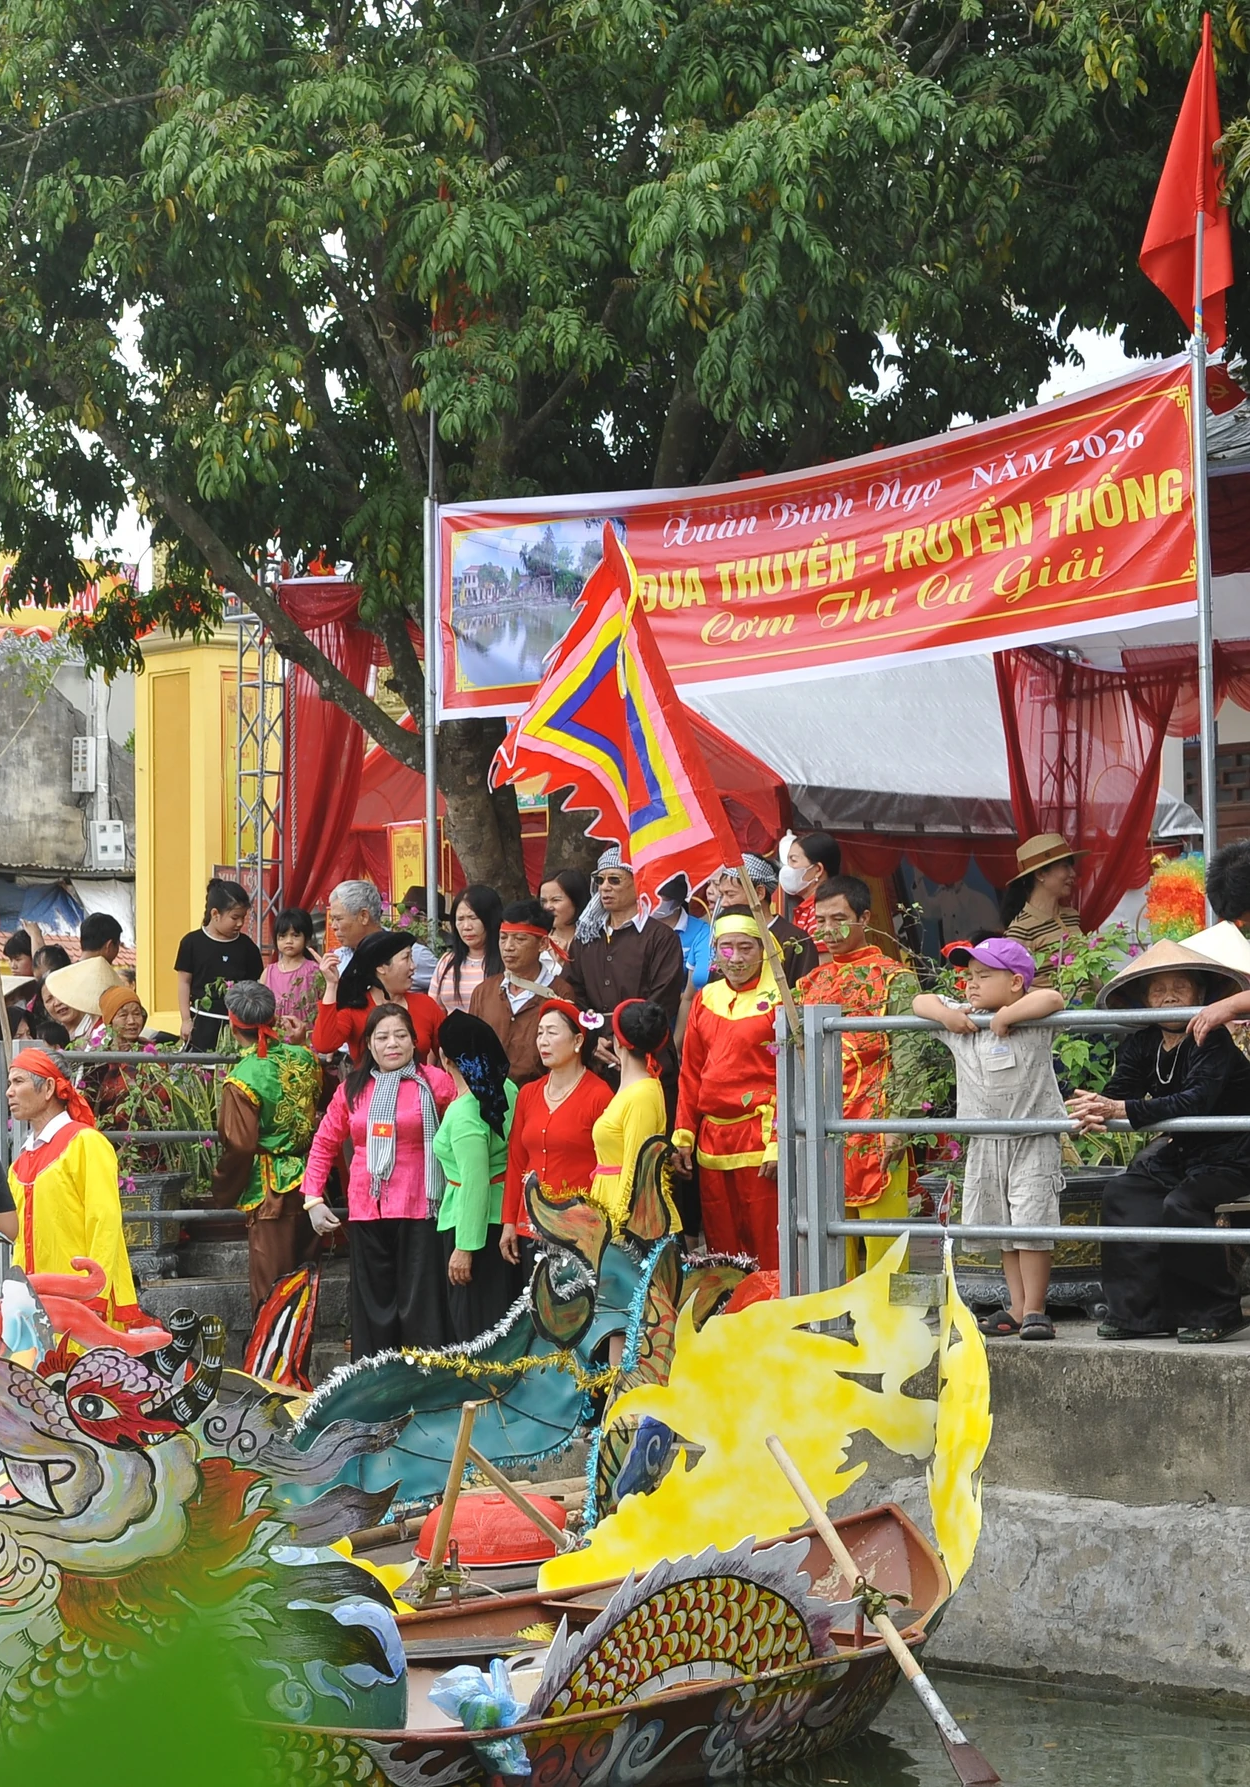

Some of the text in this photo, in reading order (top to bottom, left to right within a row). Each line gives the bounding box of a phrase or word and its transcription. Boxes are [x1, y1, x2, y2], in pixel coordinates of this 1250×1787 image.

[637, 568, 706, 613] ĐUA
[1045, 464, 1183, 539] THỐNG
[662, 514, 758, 549] Xuân
[866, 477, 943, 512] Ngọ
[969, 446, 1056, 490] NĂM
[1064, 422, 1145, 465] 2026
[700, 546, 1108, 646] Cơm Thi Cá Giải
